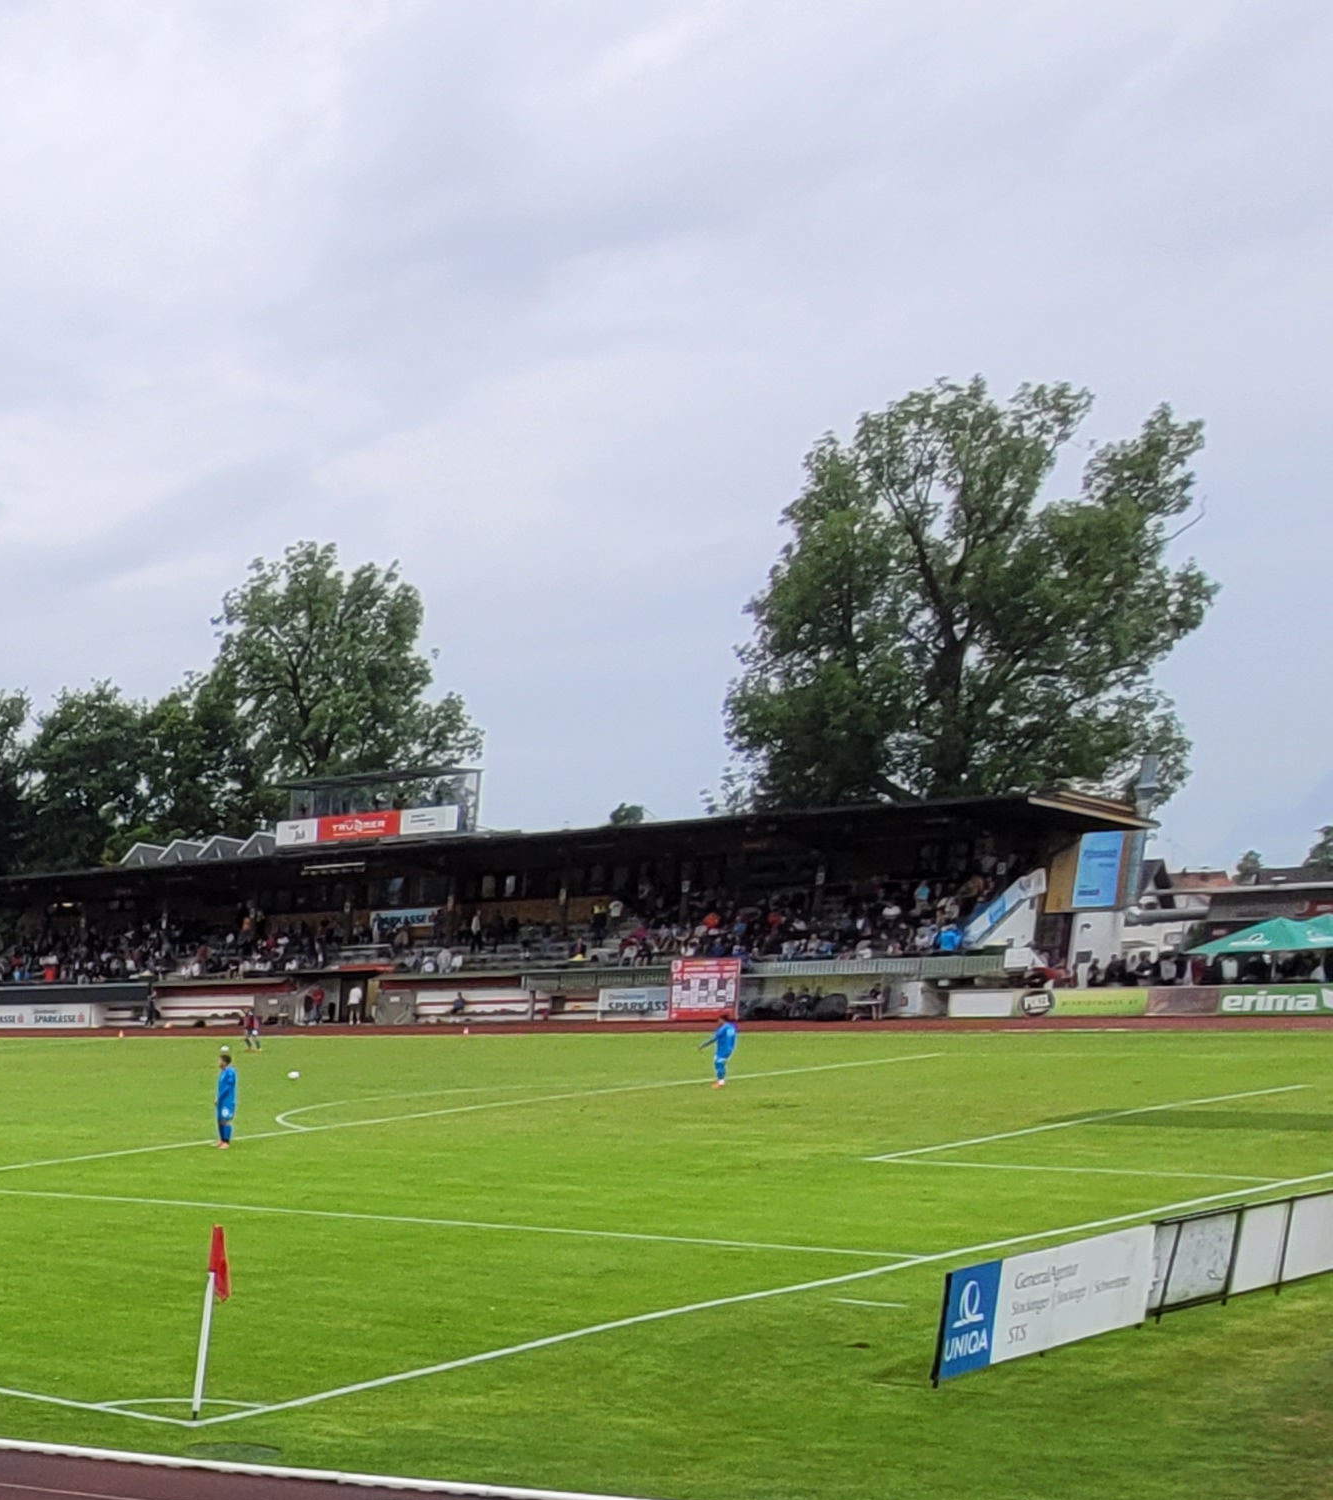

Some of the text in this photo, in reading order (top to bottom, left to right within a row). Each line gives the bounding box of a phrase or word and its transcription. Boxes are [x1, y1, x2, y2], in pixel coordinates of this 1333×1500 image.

[1221, 990, 1318, 1012] erima
[34, 1014, 76, 1024] SPARKASSE
[944, 1328, 988, 1362] UNIQA
